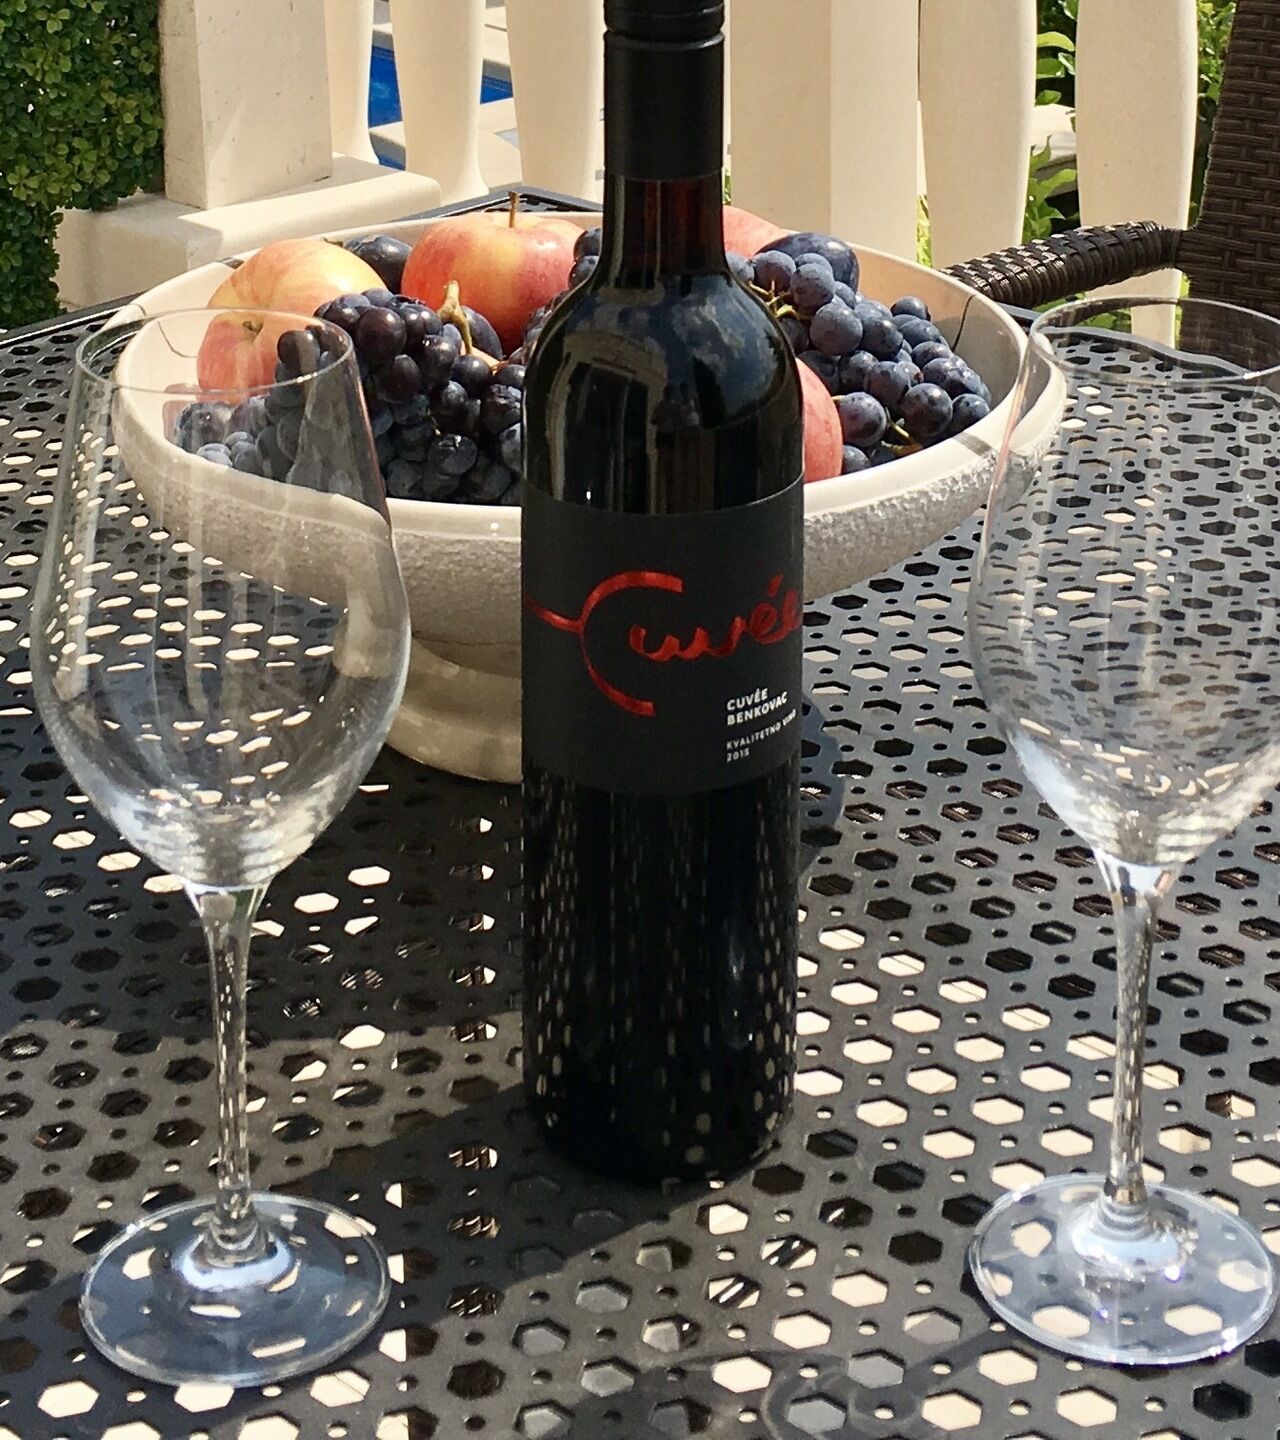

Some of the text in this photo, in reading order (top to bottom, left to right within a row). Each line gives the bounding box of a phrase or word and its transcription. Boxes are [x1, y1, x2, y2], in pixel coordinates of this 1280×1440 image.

[726, 688, 768, 711] CUVÉE
[726, 691, 788, 726] BENKOVAC
[726, 722, 781, 750] KVALITETNO
